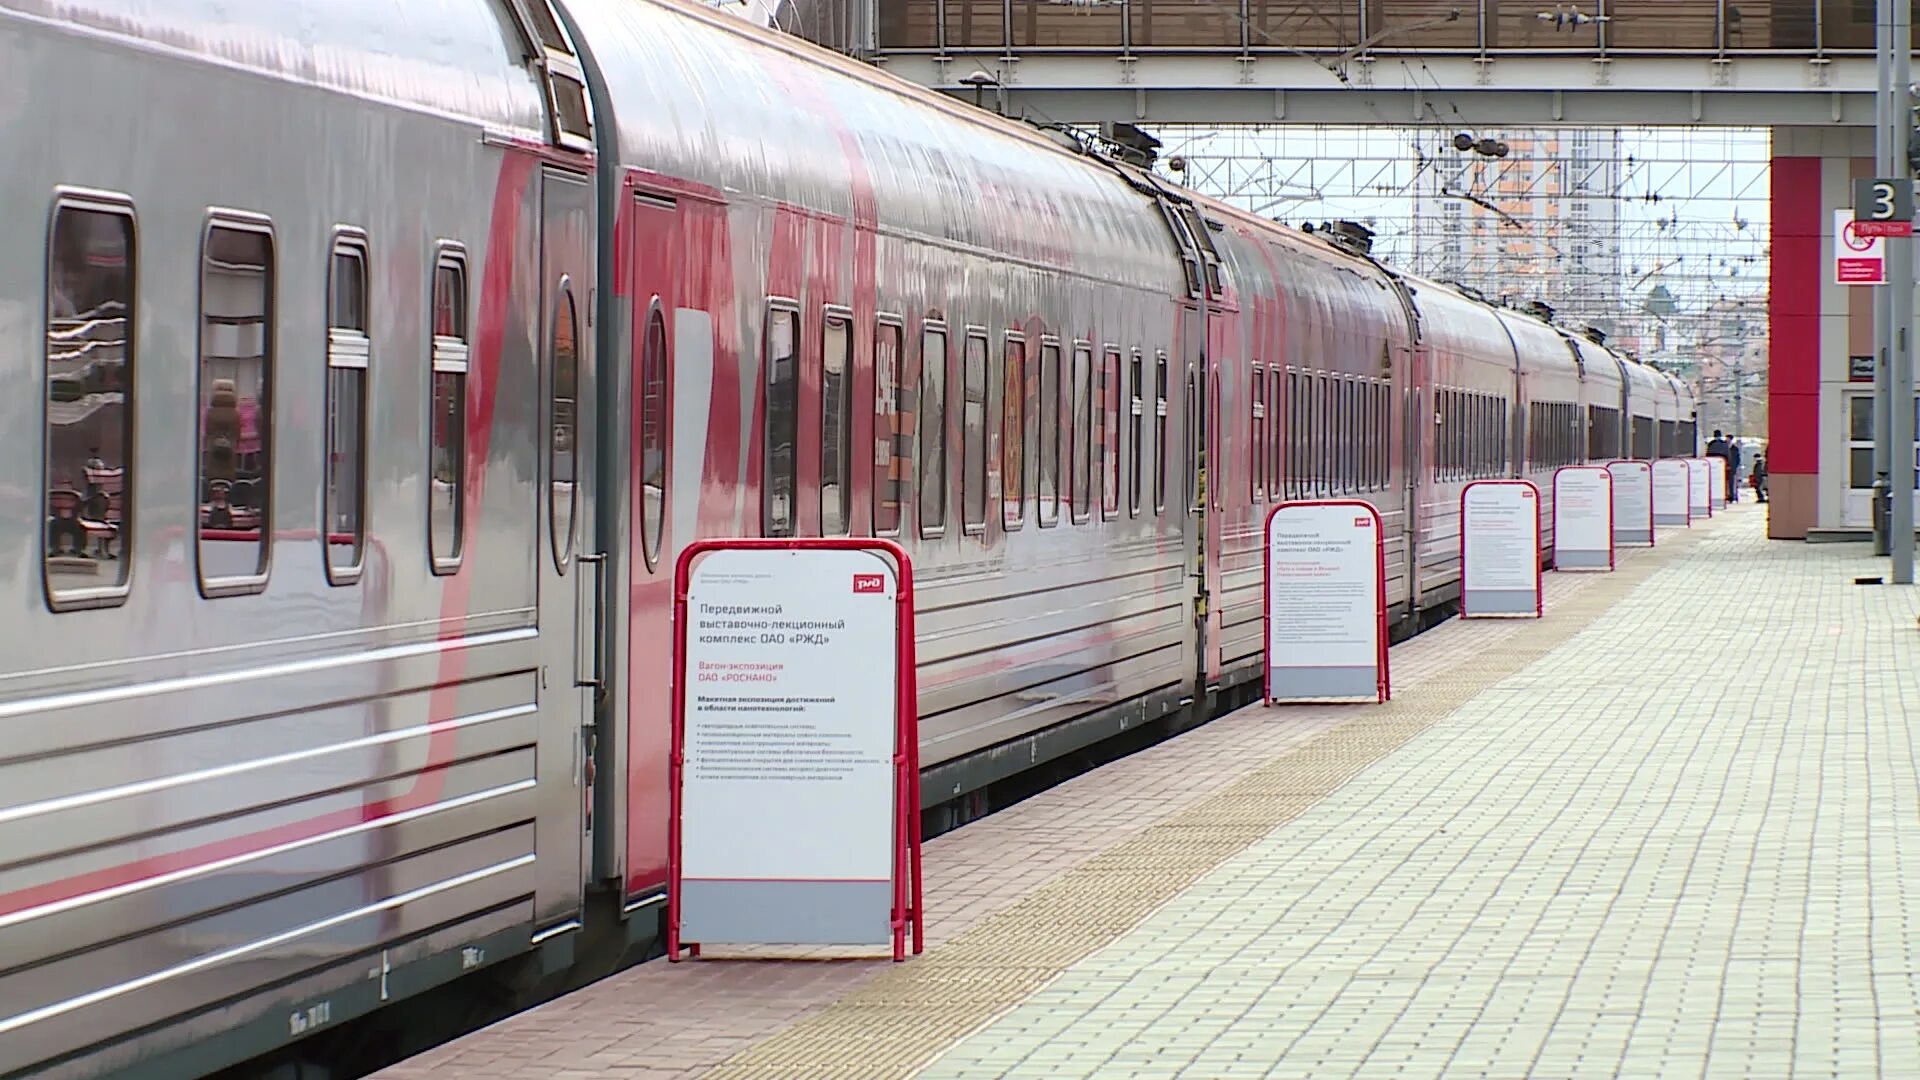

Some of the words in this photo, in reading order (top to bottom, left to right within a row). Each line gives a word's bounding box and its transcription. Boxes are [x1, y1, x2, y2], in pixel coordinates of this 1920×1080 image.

[1872, 182, 1896, 220] 3
[700, 603, 783, 615] Передвижной
[699, 619, 845, 631] выставочно-лекционный
[699, 635, 757, 644] комплекс
[760, 634, 785, 645] ОАО
[789, 634, 830, 646] «РЖД»
[698, 661, 784, 672] Вагон-экспозиция
[698, 673, 718, 682] ОАО
[721, 673, 778, 683] «РОСНАНО»
[697, 695, 737, 704] Макетная
[738, 696, 785, 705] экспозиция
[785, 695, 836, 704] достижений
[704, 704, 737, 712] области
